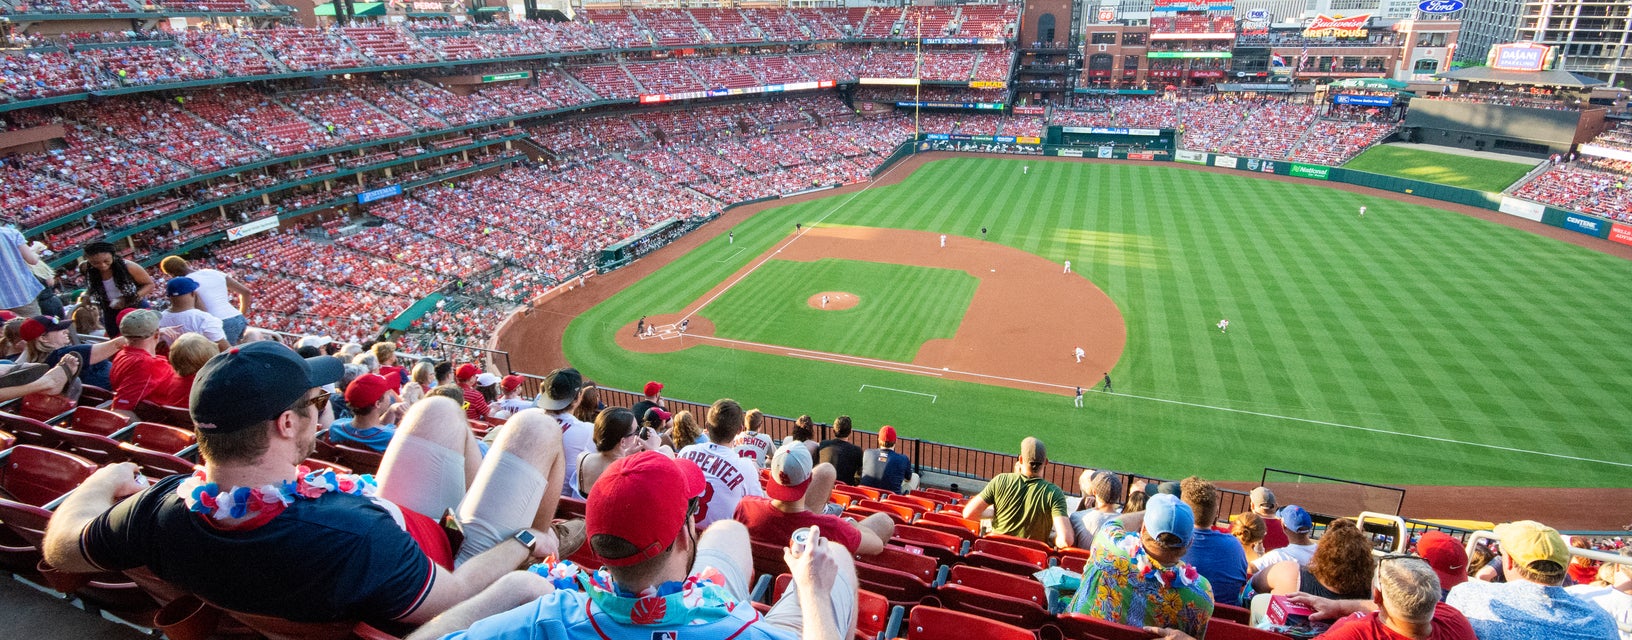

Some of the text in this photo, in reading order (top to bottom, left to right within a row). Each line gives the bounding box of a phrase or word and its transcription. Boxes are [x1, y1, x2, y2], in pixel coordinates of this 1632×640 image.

[413, 1, 443, 10] PERCH
[1425, 0, 1455, 11] Ford
[1311, 18, 1368, 29] Budweiser
[1302, 29, 1369, 38] BREW HOUSE
[1501, 49, 1538, 61] DASANI
[1299, 166, 1328, 175] National
[1566, 216, 1597, 229] CENTENE
[680, 451, 745, 491] ARPENTER
